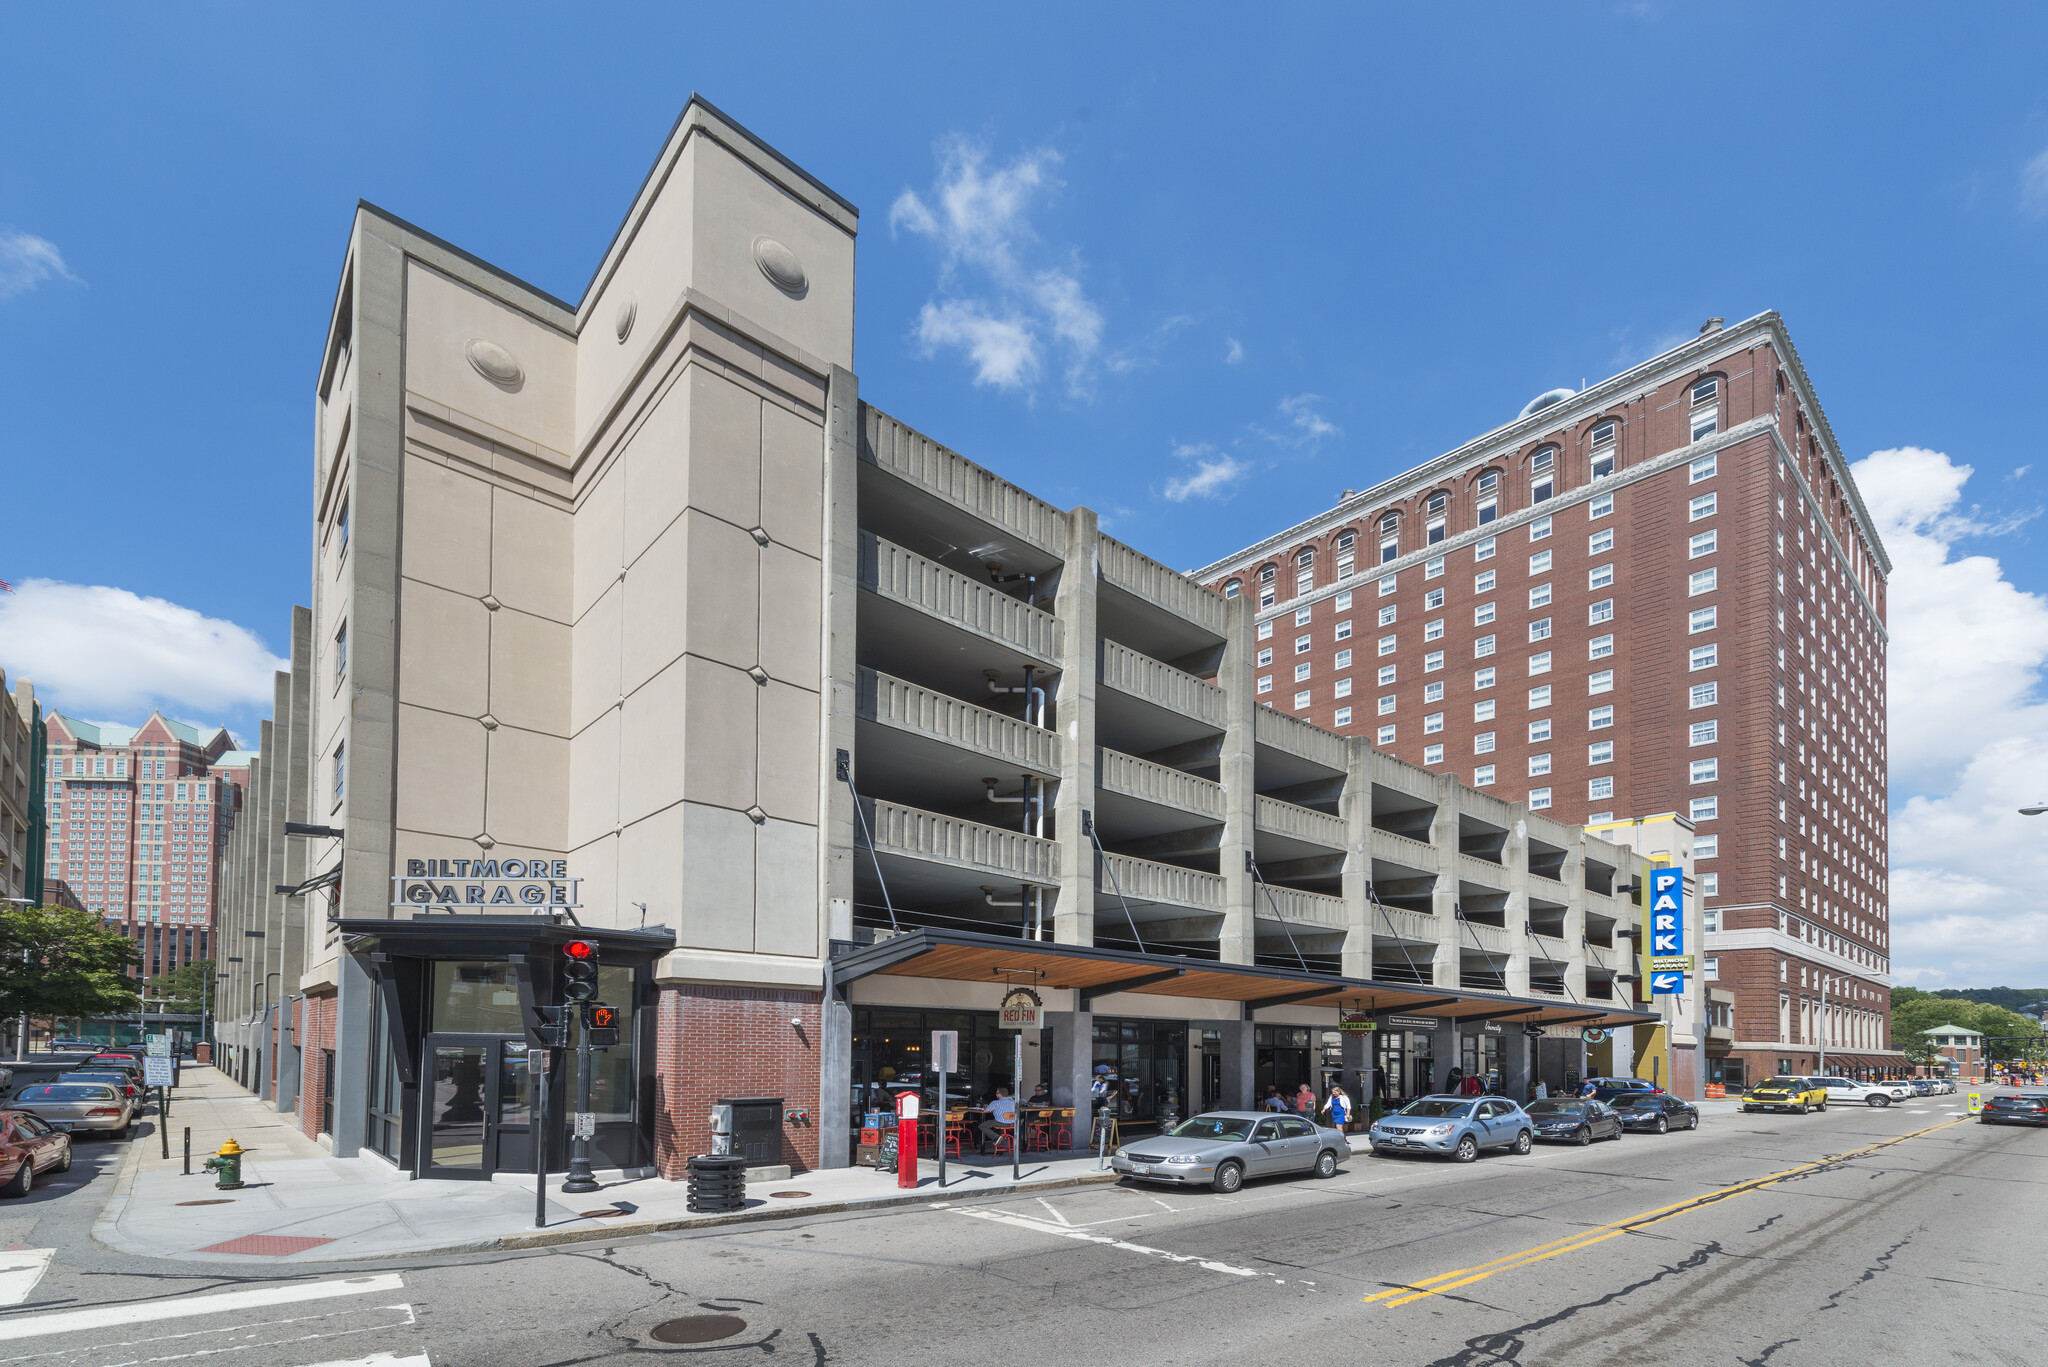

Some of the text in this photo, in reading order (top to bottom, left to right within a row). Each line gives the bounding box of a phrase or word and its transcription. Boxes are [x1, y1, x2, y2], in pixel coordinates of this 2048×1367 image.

[407, 859, 567, 878] BILTMORE
[406, 884, 566, 904] GARAGE
[1653, 875, 1678, 951] PARK
[1003, 1009, 1036, 1021] RED FIN
